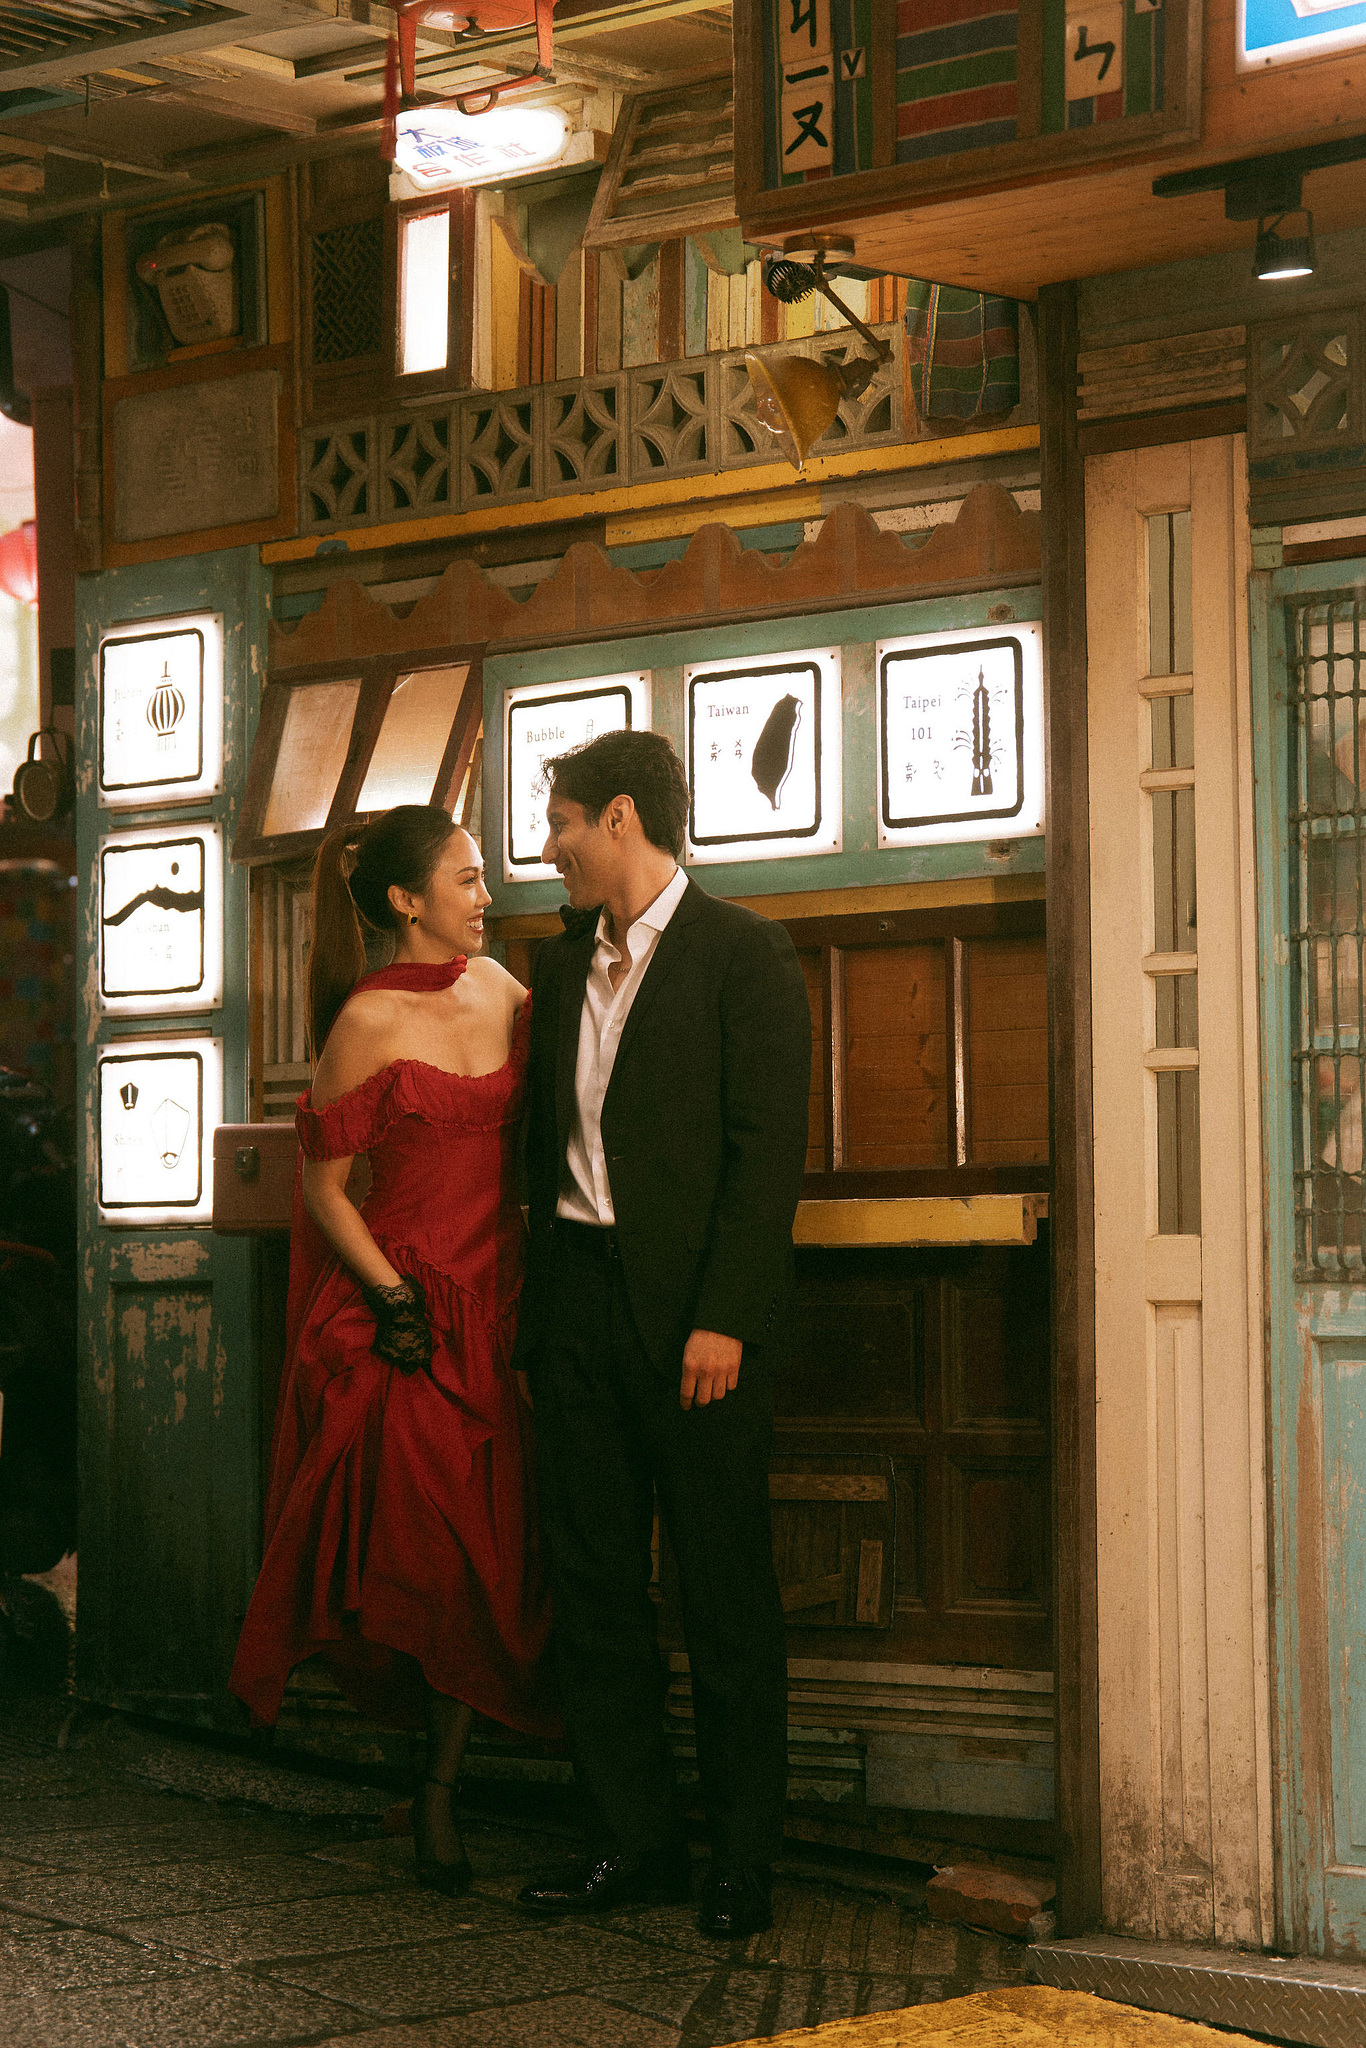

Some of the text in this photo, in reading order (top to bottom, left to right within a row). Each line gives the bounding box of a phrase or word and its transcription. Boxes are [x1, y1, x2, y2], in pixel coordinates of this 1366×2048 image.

[707, 704, 750, 718] Taiwan
[903, 694, 942, 713] Taipei
[526, 727, 566, 744] Bubble
[911, 726, 933, 741] 101
